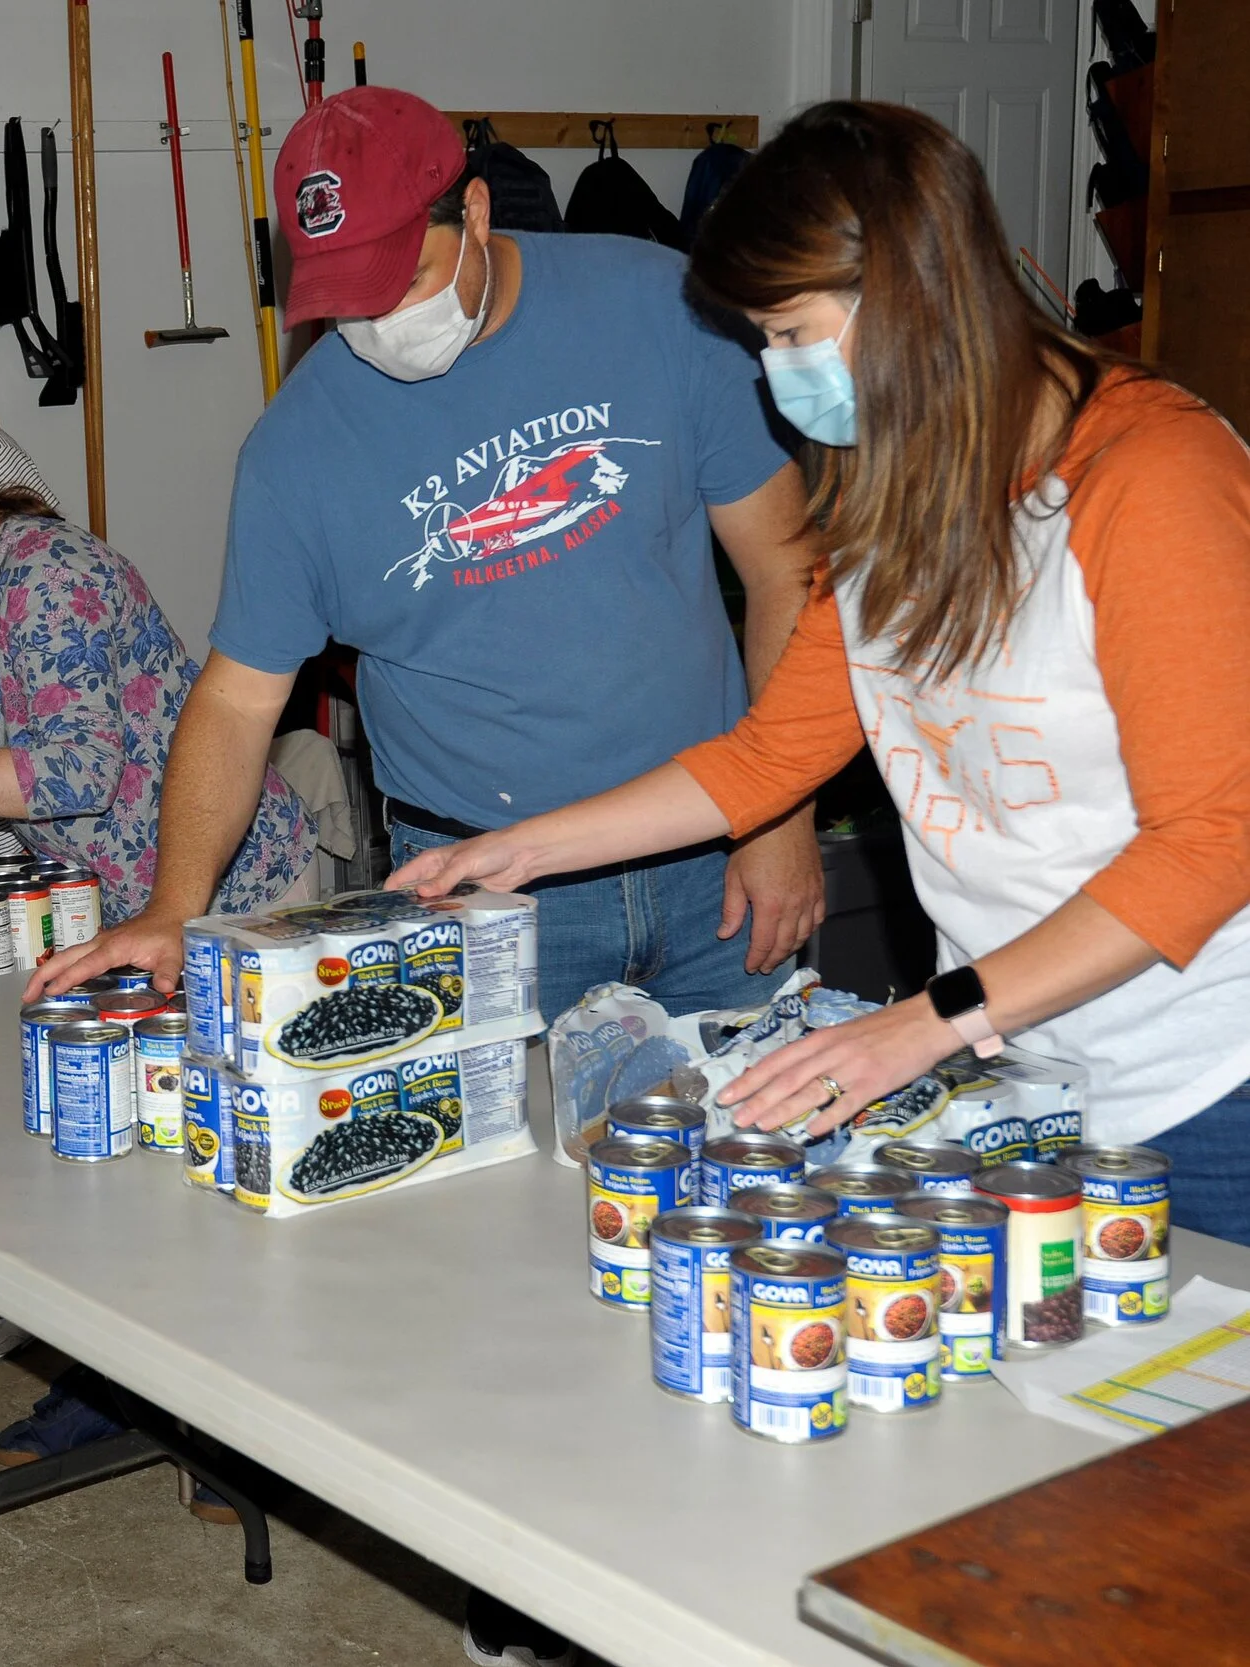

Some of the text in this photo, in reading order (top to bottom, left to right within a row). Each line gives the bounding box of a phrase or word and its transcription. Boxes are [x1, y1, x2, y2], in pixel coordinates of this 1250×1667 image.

[401, 402, 612, 520] K2 AVIATION
[453, 500, 622, 586] TALKEETNA, ALASKA
[404, 924, 461, 956] GOYA
[351, 944, 398, 967] GOYA
[412, 958, 433, 968] Black
[402, 1052, 457, 1082] GOYA
[232, 1085, 300, 1112] GOYA
[353, 1073, 398, 1099] GOYA
[970, 1124, 1027, 1152] GOYA
[1030, 1115, 1080, 1140] GOYA
[849, 1205, 870, 1213] Black
[847, 1256, 901, 1275] GOYA
[752, 1282, 809, 1303] GOYA
